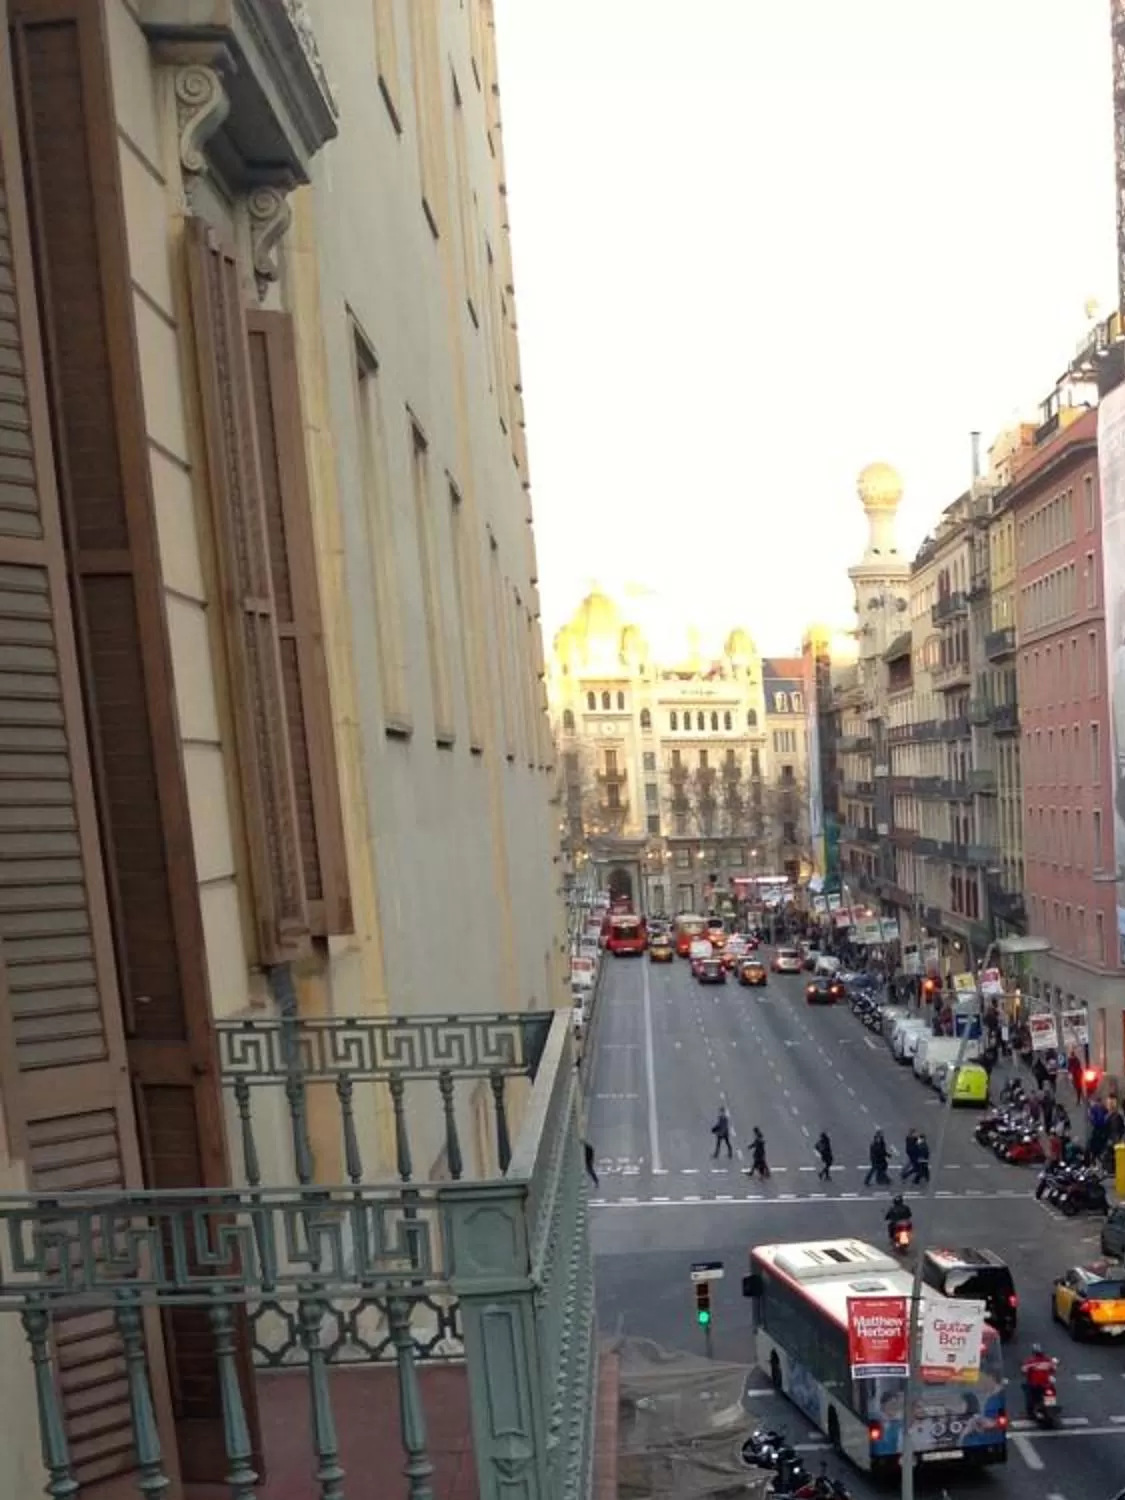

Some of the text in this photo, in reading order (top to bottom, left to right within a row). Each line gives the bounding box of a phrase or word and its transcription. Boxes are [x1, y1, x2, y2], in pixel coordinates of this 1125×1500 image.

[853, 1315, 903, 1328] Matthew
[933, 1318, 975, 1333] Guitar
[939, 1332, 966, 1345] Bcn
